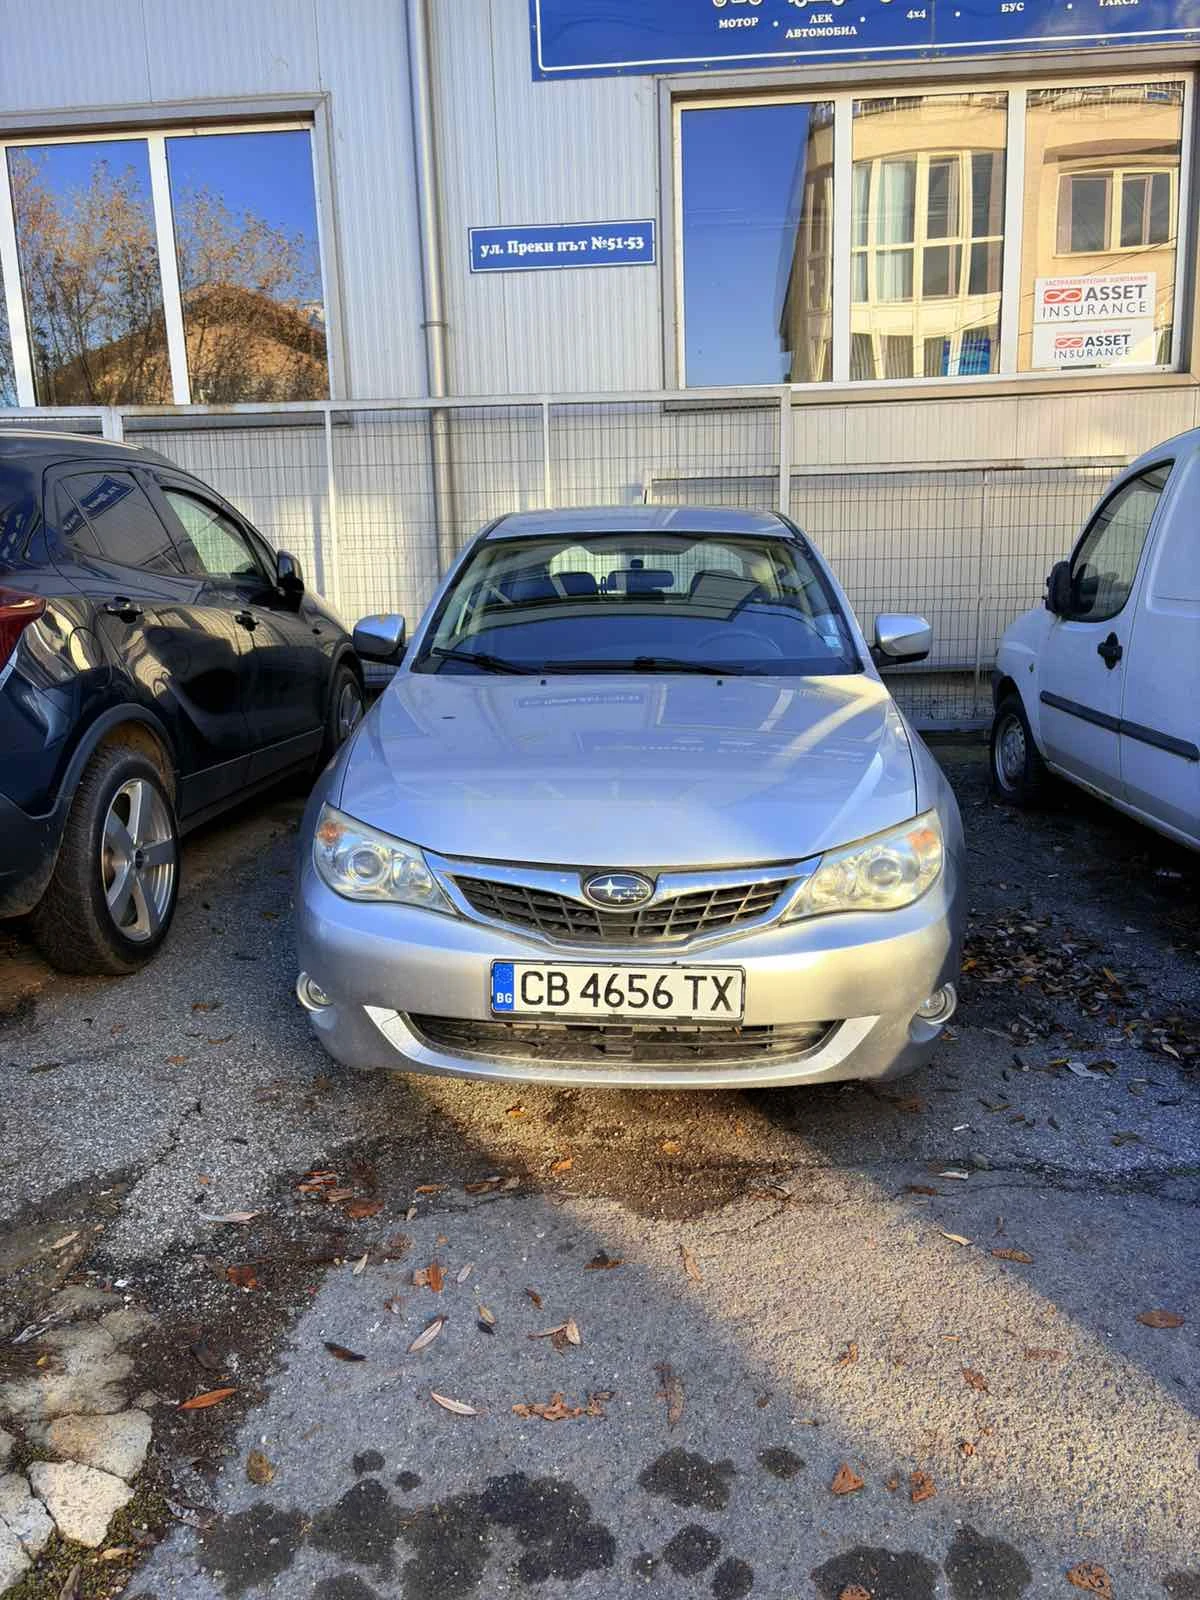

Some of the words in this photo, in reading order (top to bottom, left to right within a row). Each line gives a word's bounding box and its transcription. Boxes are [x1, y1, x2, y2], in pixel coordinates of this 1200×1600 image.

[1001, 2, 1025, 13] БУС
[718, 17, 759, 29] МОТОР
[809, 13, 833, 24] ЛЕК
[785, 26, 858, 39] АВТОМОБИЛ
[480, 243, 504, 258] ул.
[507, 239, 554, 256] Преки
[557, 240, 588, 254] път
[591, 236, 645, 250] №51-53
[1084, 284, 1147, 301] ASSET
[1042, 301, 1146, 318] INSURANCE
[1084, 334, 1131, 347] ASSET
[1053, 346, 1130, 359] INSURANCE
[520, 971, 570, 1006] CB
[580, 973, 673, 1009] 4656
[684, 975, 734, 1011] TX
[496, 993, 513, 1004] BG
